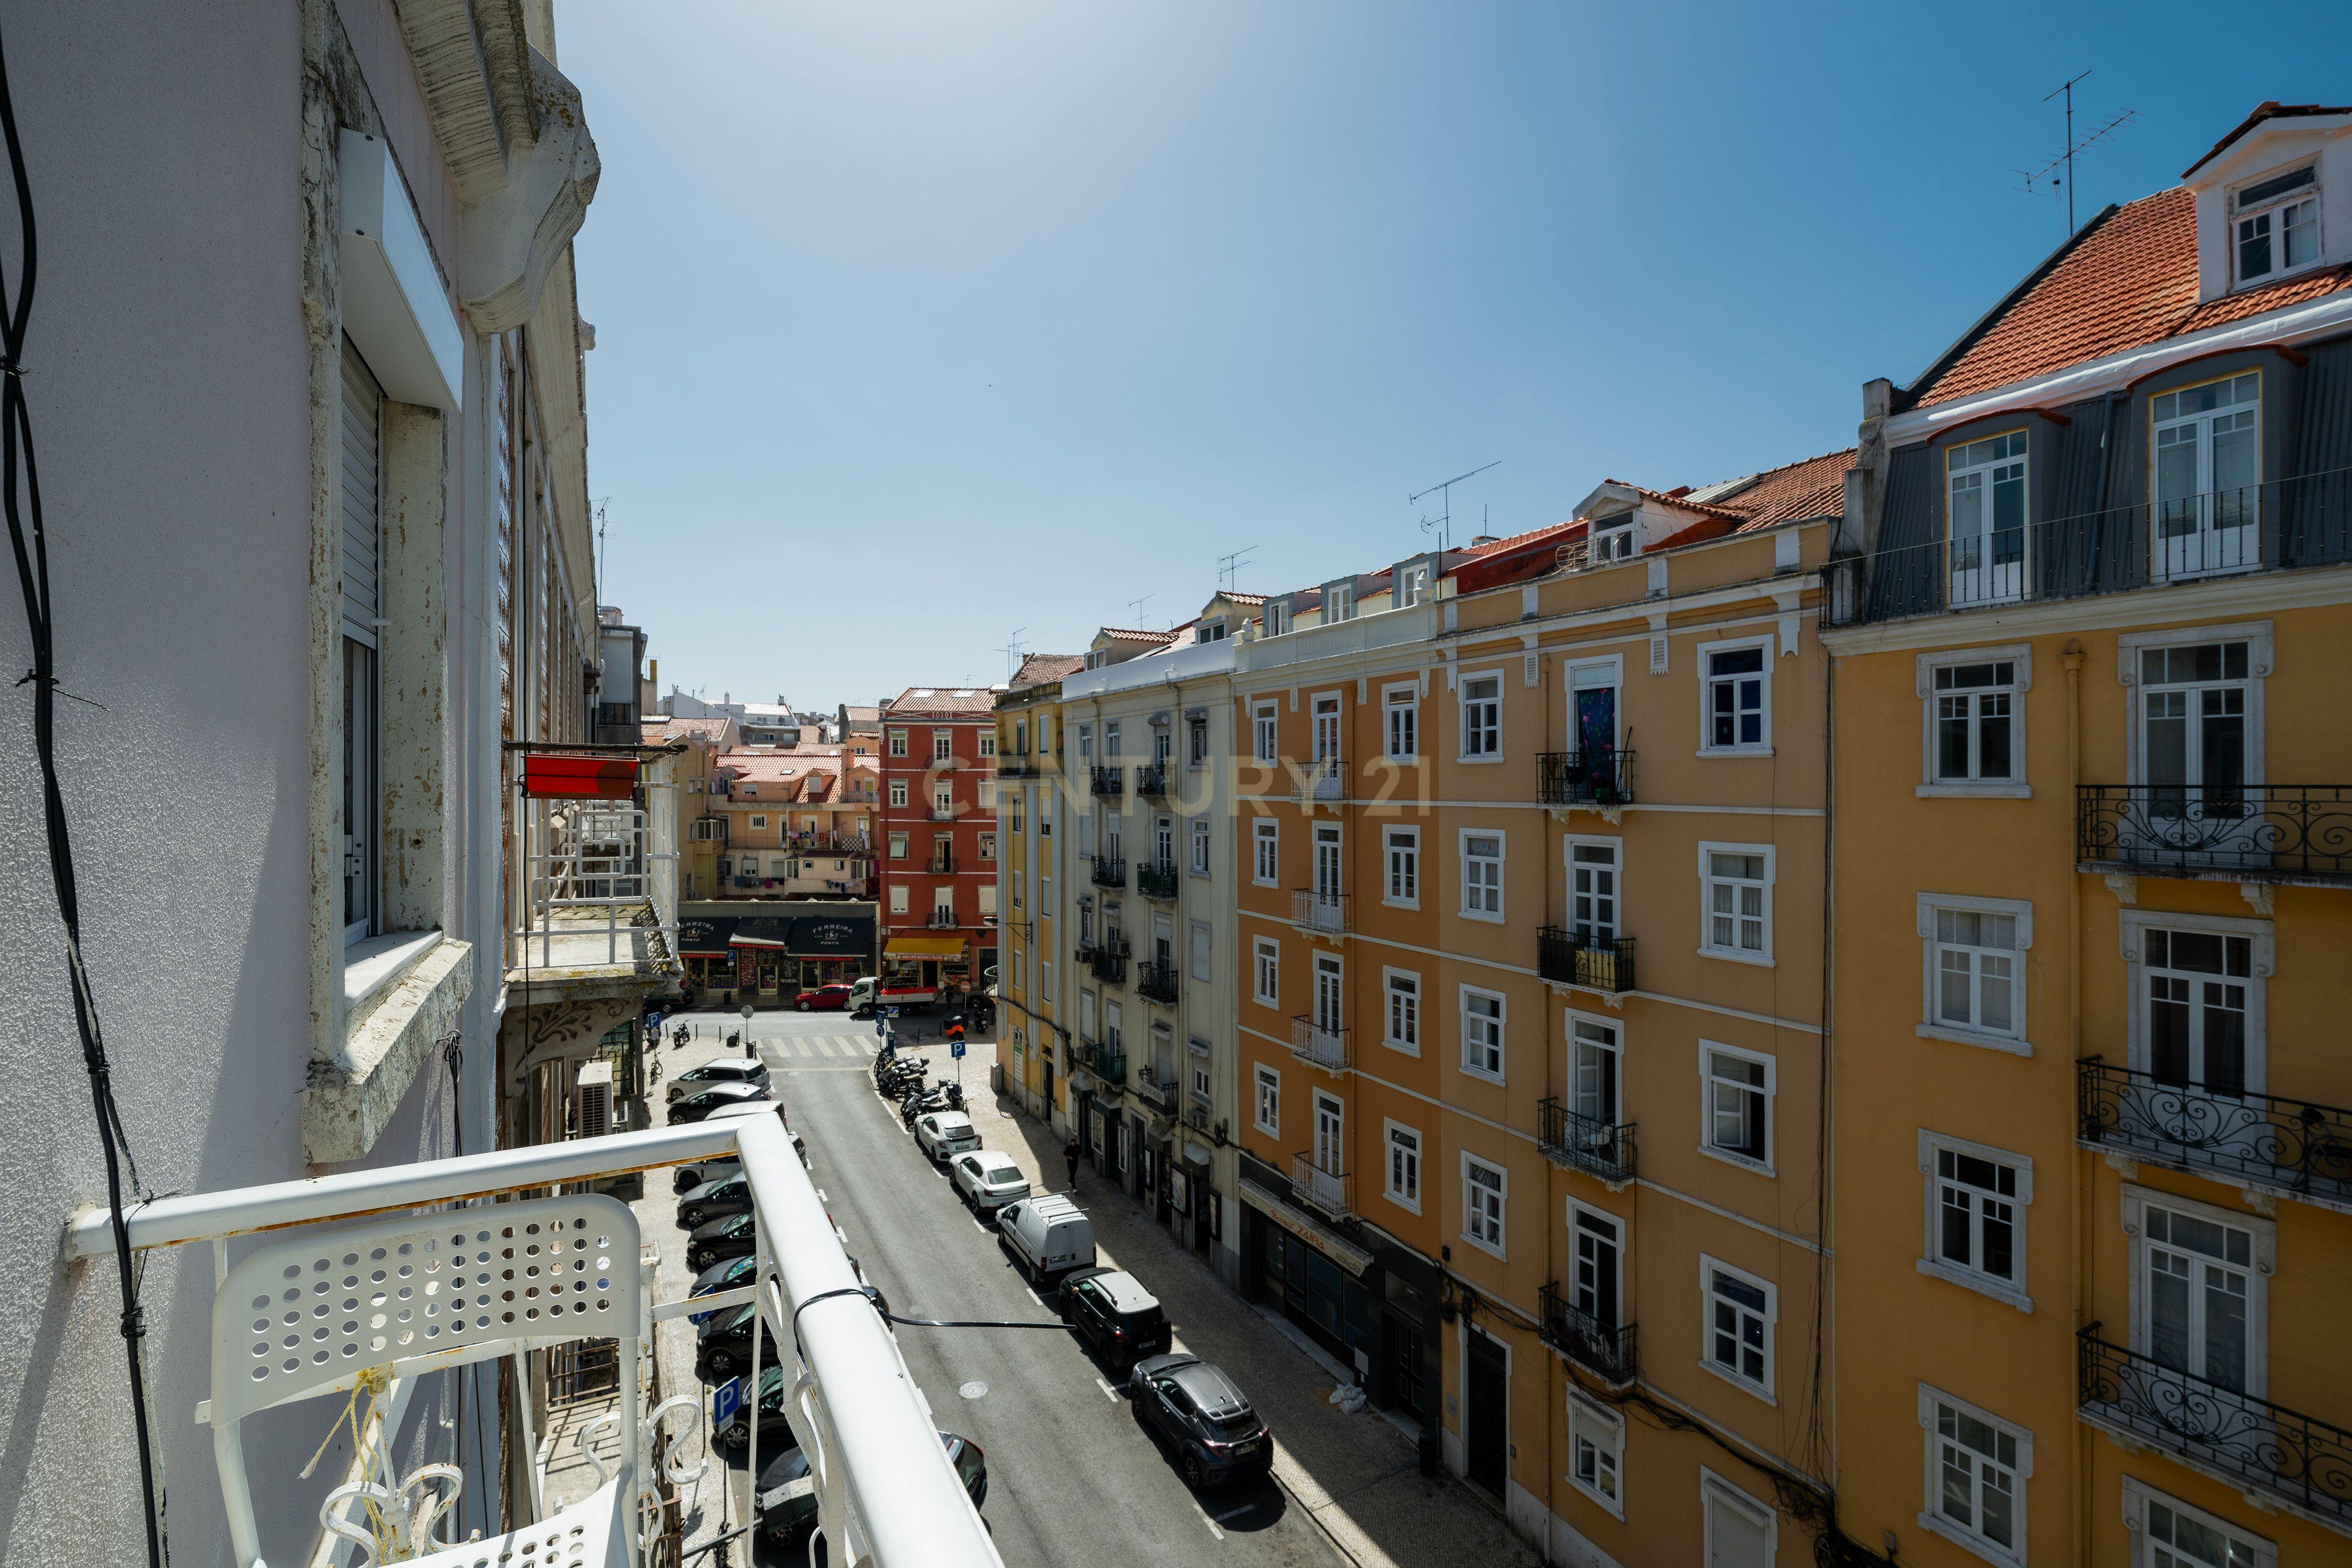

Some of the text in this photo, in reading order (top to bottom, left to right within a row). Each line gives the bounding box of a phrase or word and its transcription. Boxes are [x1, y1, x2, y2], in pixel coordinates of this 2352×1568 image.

[680, 921, 715, 931] ERREIRA
[812, 925, 853, 934] FERREIRA
[651, 1015, 658, 1027] P
[954, 1043, 963, 1056] P
[1140, 1083, 1164, 1101] ADVOGADOS
[1243, 1192, 1256, 1205] ESTOFOS
[1335, 1253, 1360, 1273] DECORAÇÕES
[720, 1386, 734, 1418] P
